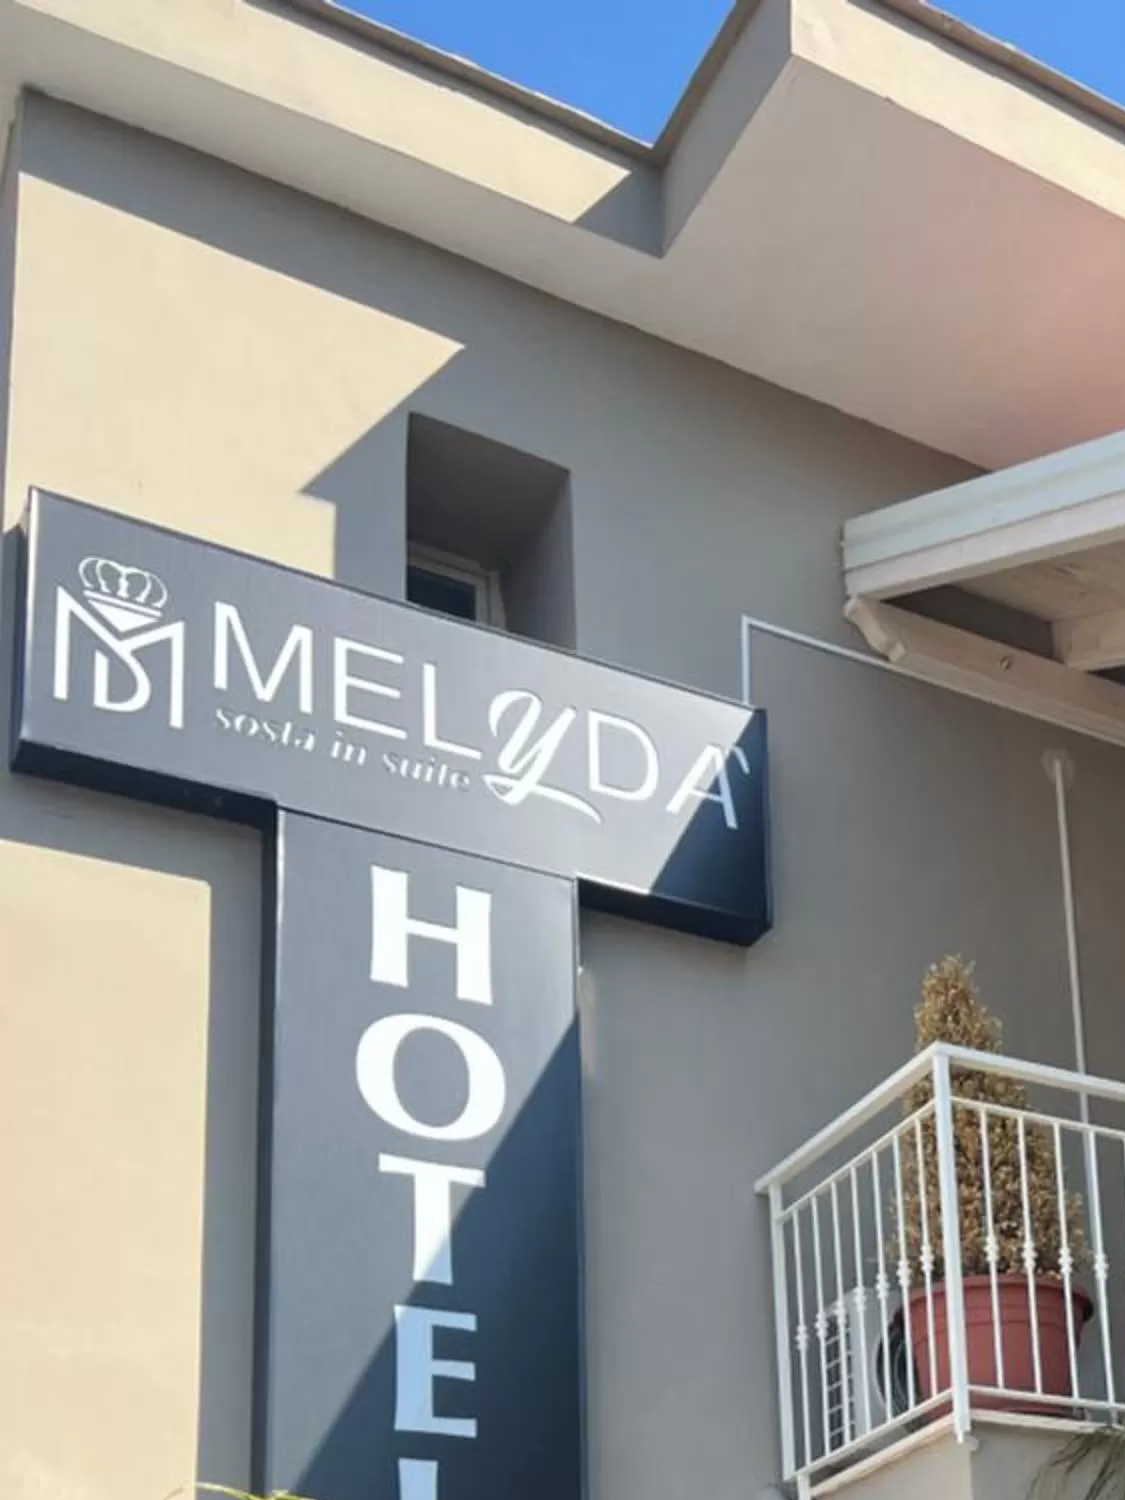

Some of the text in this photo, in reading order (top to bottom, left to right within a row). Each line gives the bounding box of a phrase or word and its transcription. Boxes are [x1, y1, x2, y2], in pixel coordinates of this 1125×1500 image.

[215, 707, 471, 790] sosta in suite
